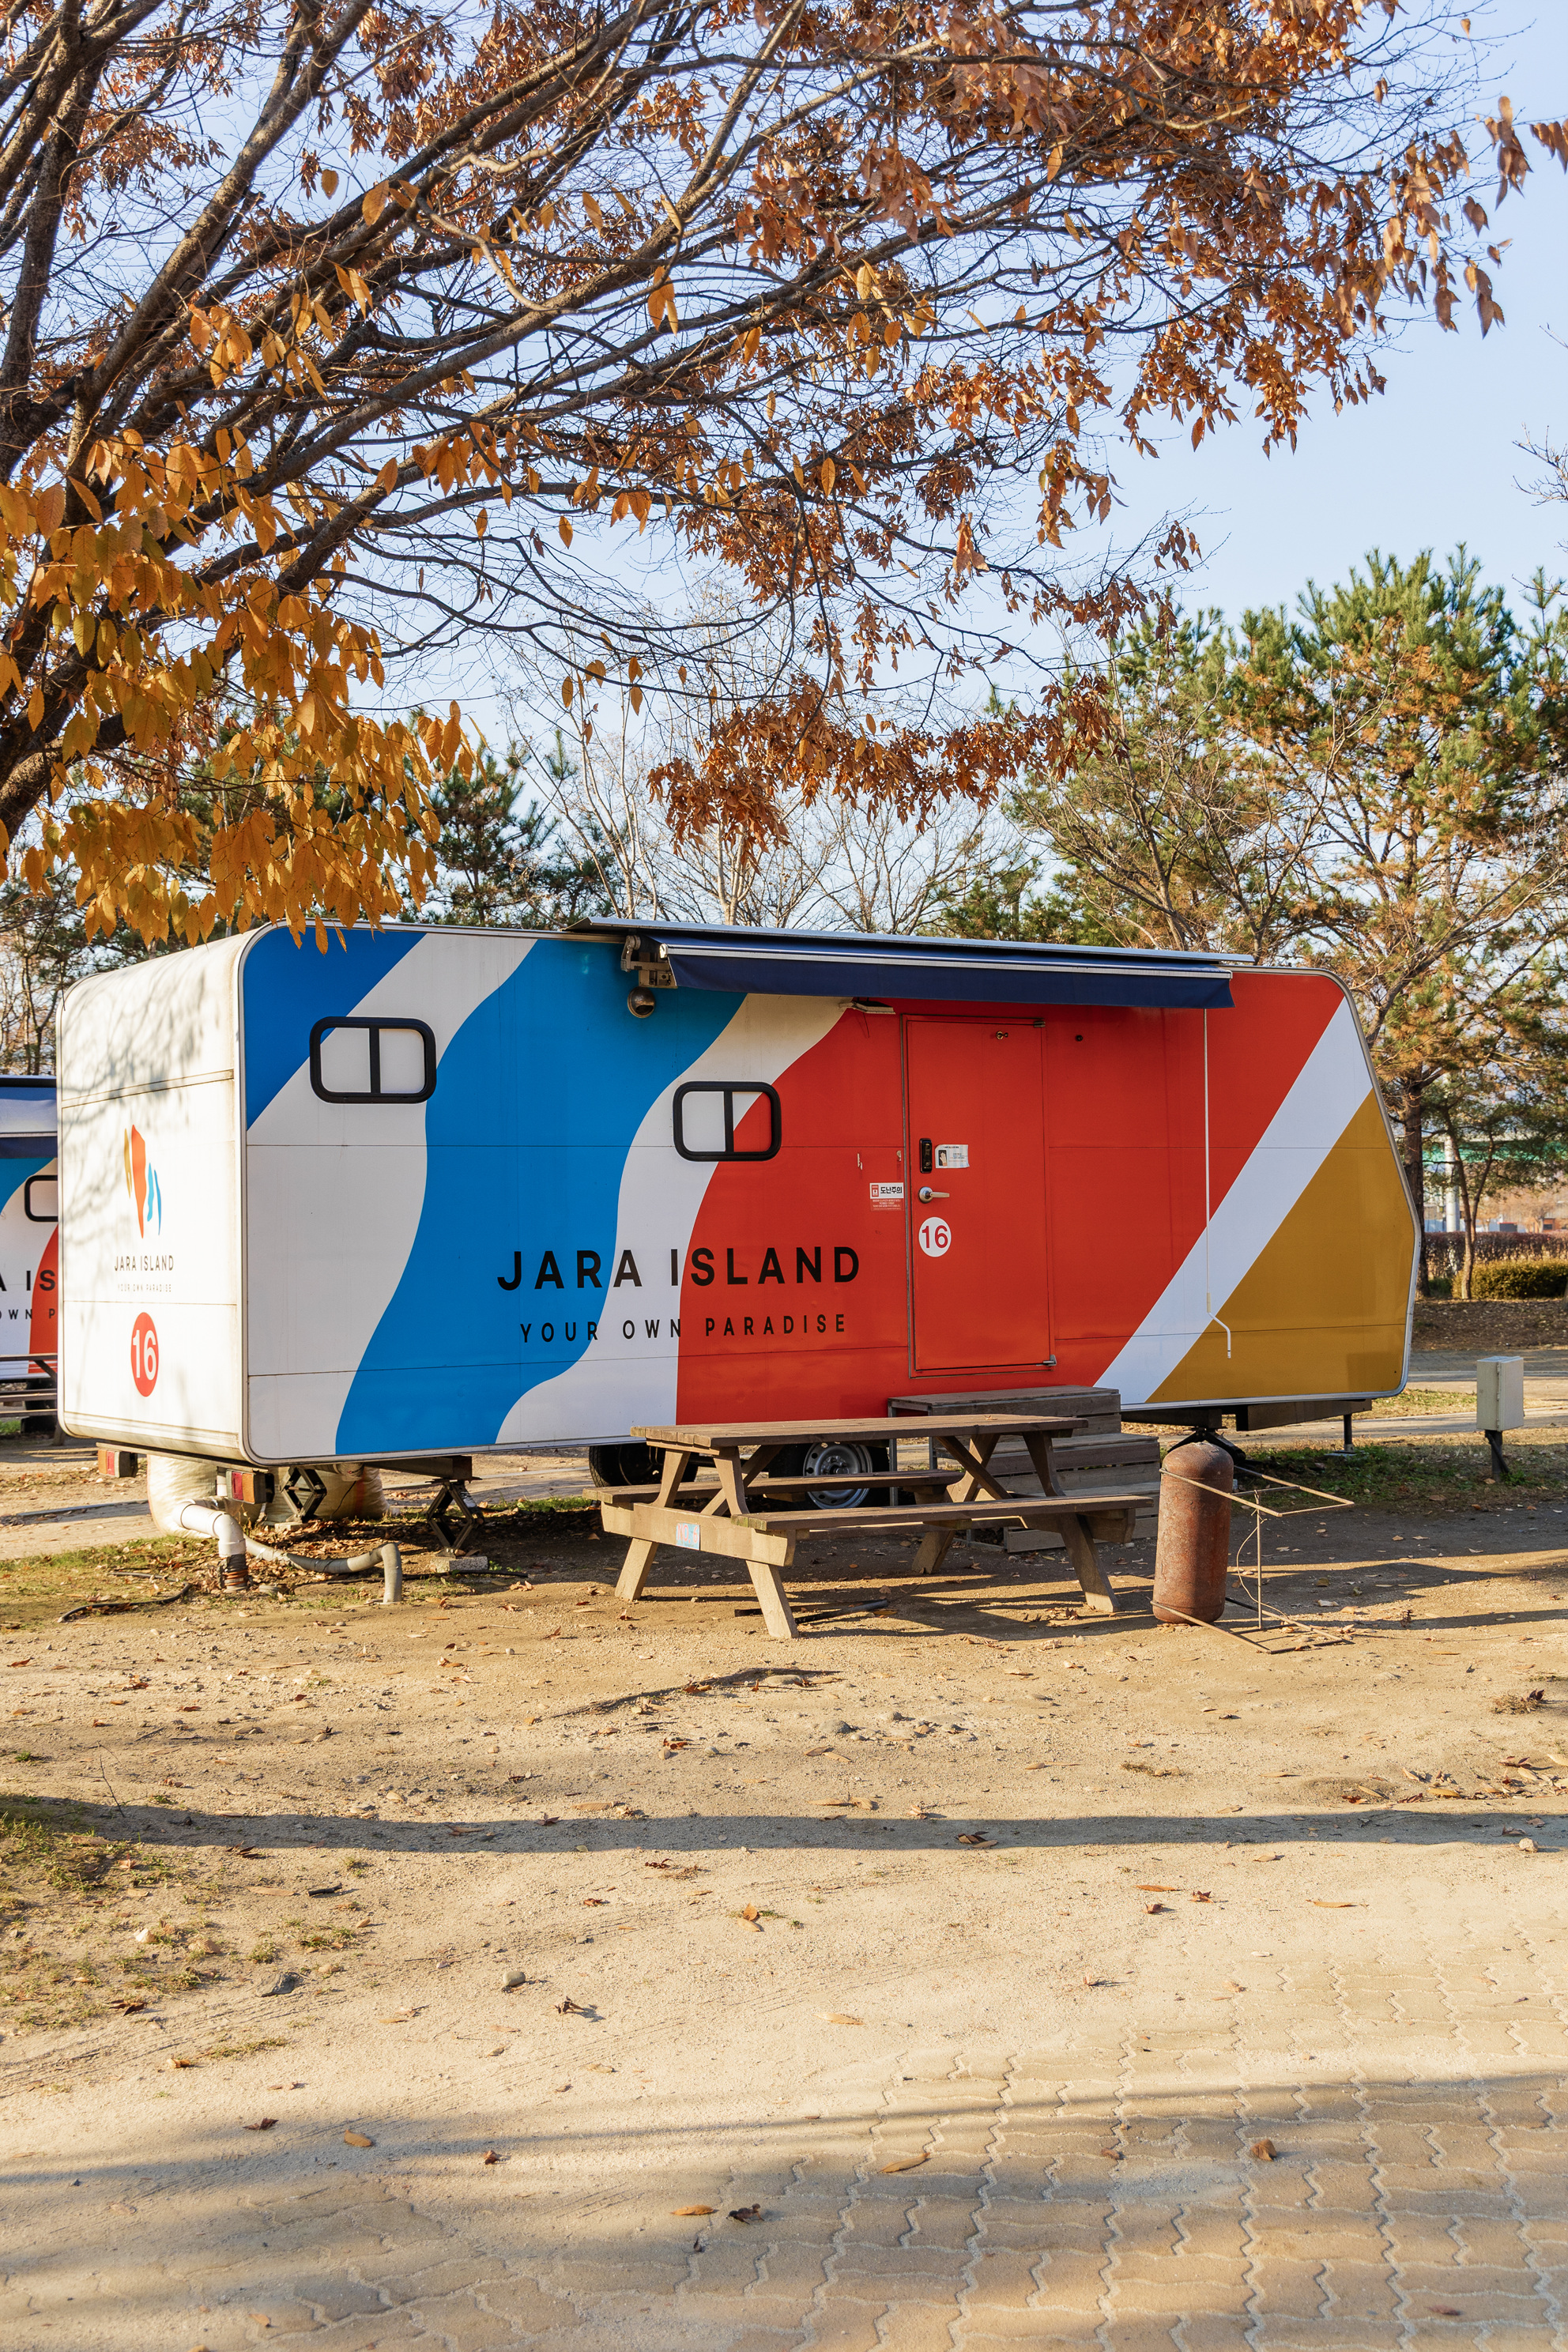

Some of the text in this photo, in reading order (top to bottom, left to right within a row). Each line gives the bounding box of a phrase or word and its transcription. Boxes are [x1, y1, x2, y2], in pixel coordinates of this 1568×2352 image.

[922, 1225, 948, 1249] 16
[115, 1255, 174, 1271] JARA ISLAND
[497, 1246, 859, 1291] JARA ISLAND
[0, 1309, 32, 1320] WN
[520, 1314, 845, 1343] YOUR OWN PARADISE
[133, 1329, 156, 1381] 16
[693, 1525, 698, 1544] 6
